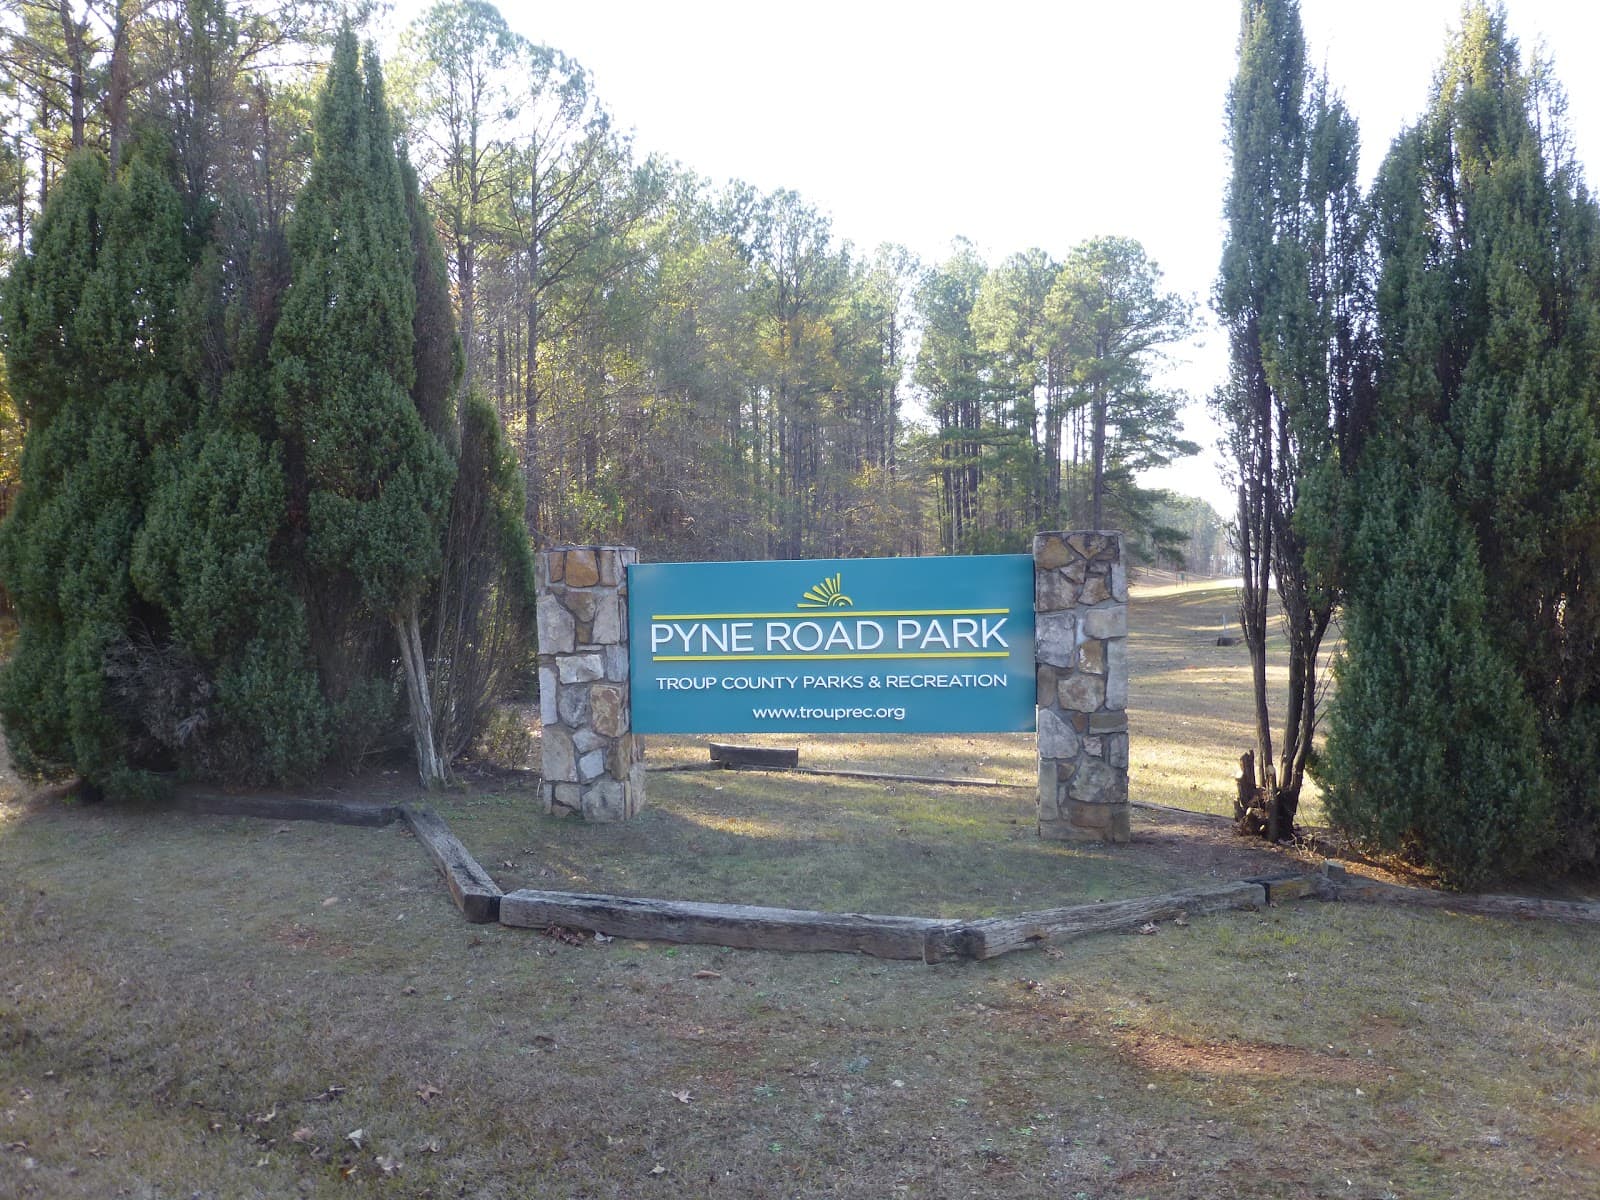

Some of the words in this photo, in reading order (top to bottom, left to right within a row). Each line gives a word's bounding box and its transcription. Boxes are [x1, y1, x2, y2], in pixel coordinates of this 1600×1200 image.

[651, 622, 755, 653] PYNE
[766, 620, 884, 652] ROAD
[897, 618, 1009, 649] PARK
[656, 677, 717, 690] TROUP
[721, 676, 798, 690] COUNTY
[803, 676, 863, 689] PARKS
[868, 675, 881, 689] &
[886, 674, 1008, 688] RECREATION
[753, 706, 905, 721] www.trouprec.org
